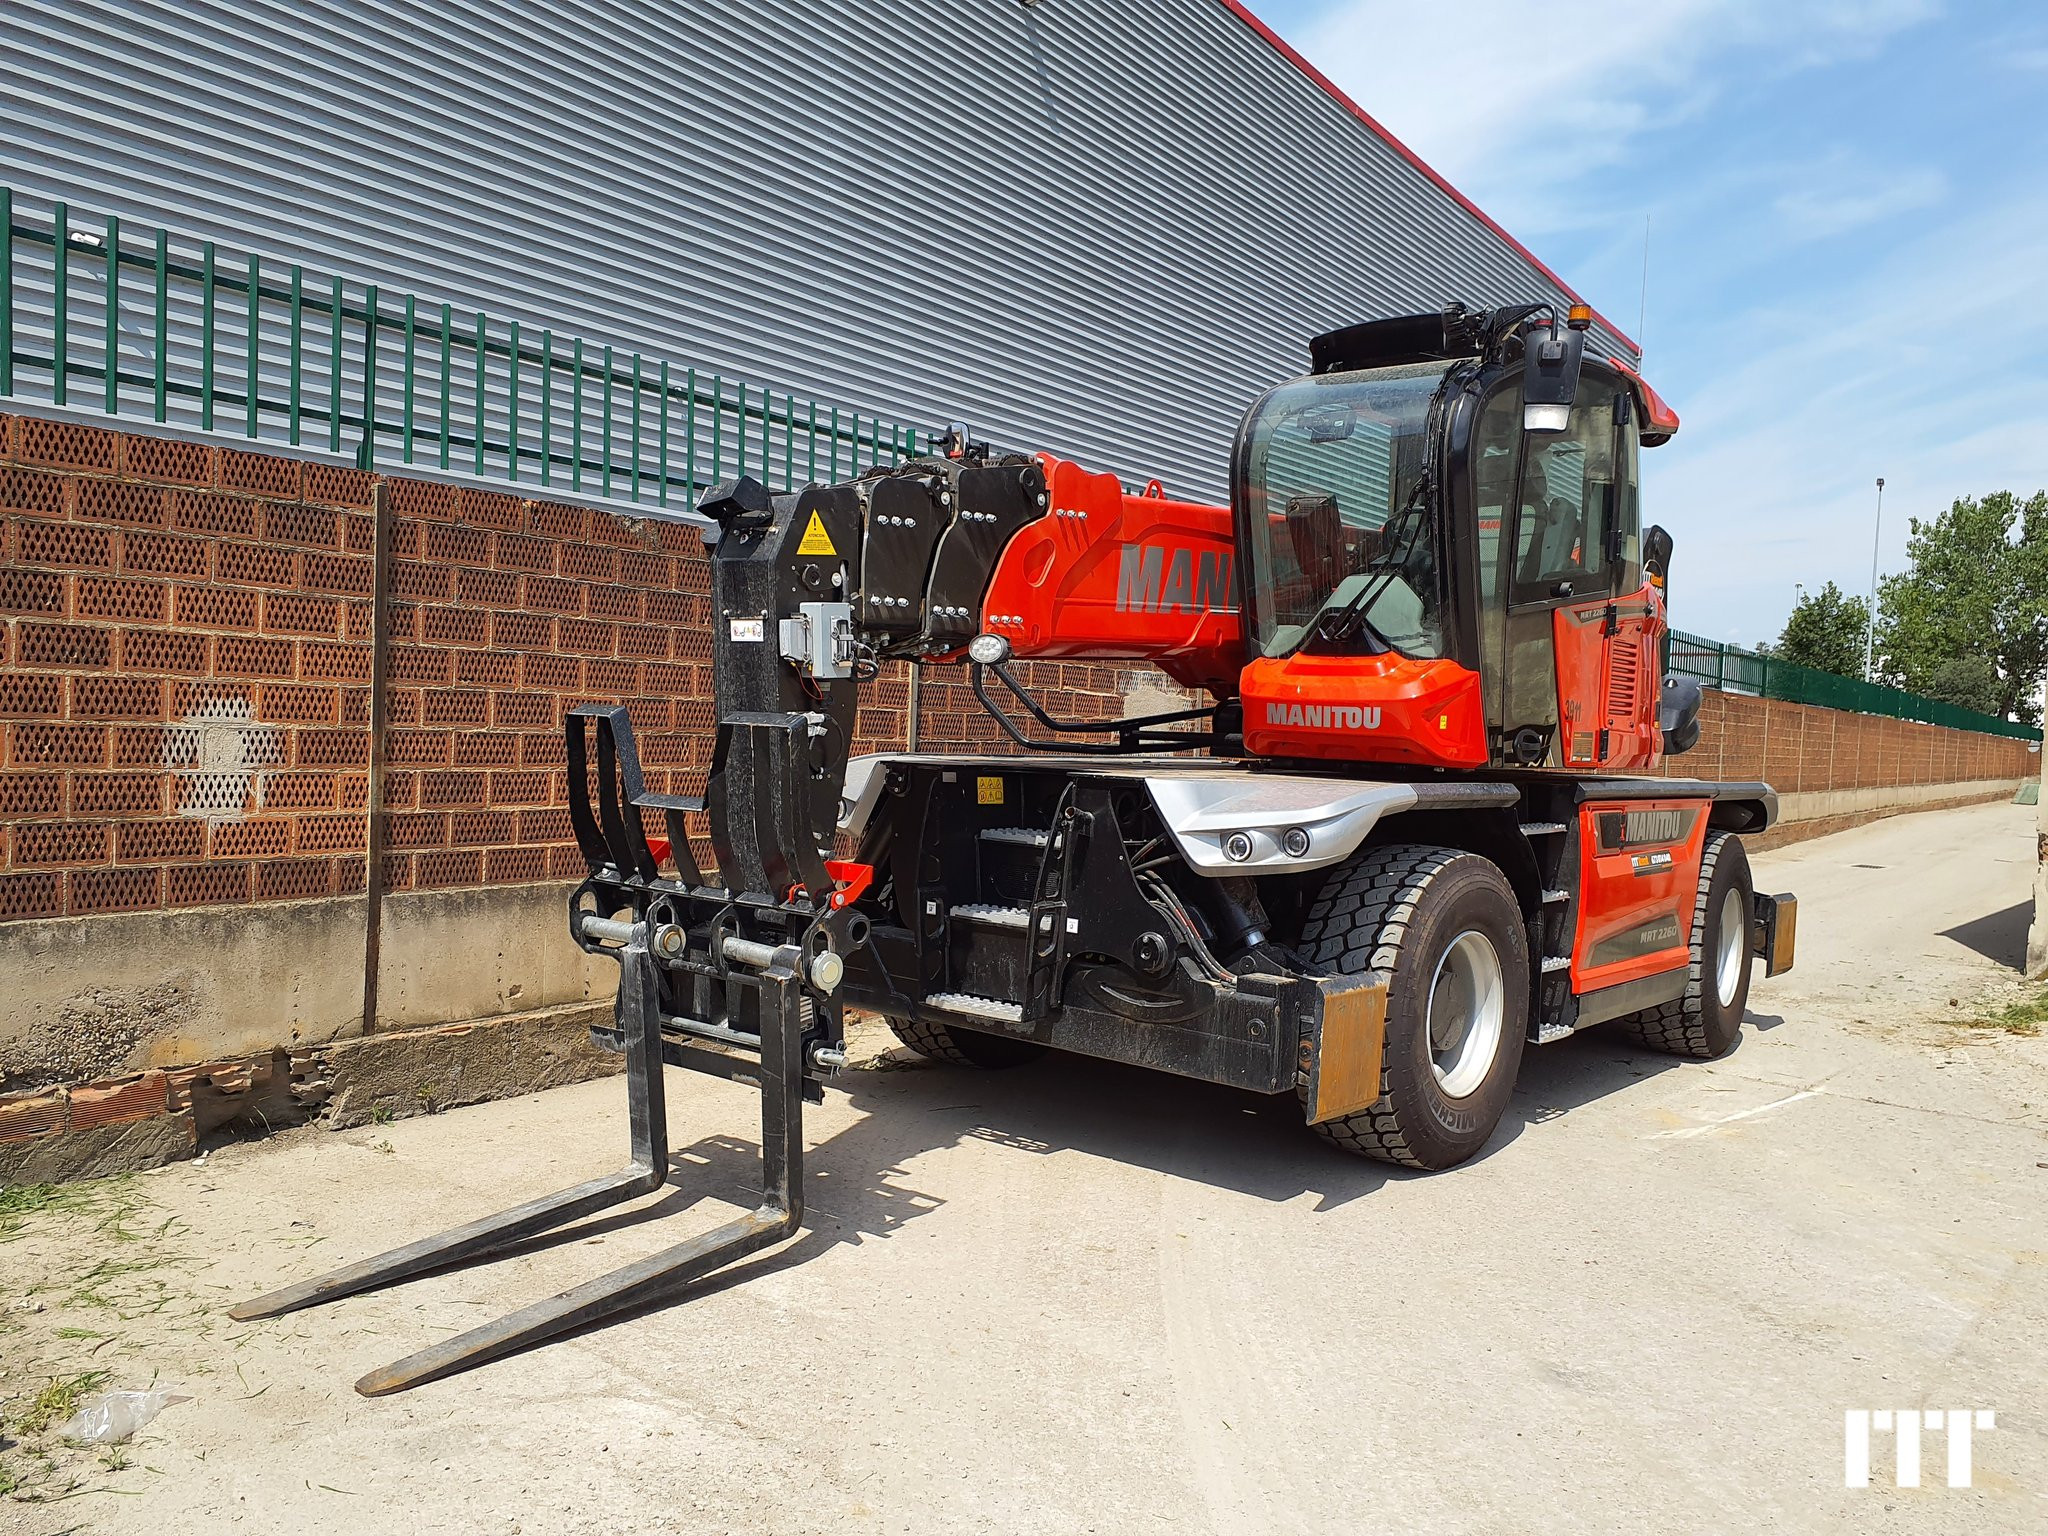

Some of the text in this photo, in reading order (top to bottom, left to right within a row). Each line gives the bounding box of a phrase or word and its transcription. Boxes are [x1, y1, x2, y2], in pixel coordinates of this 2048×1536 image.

[1592, 607, 1607, 617] 2260
[1266, 702, 1382, 730] MANITOU
[1625, 811, 1681, 842] MANITOU
[1640, 925, 1677, 944] MRT 2260
